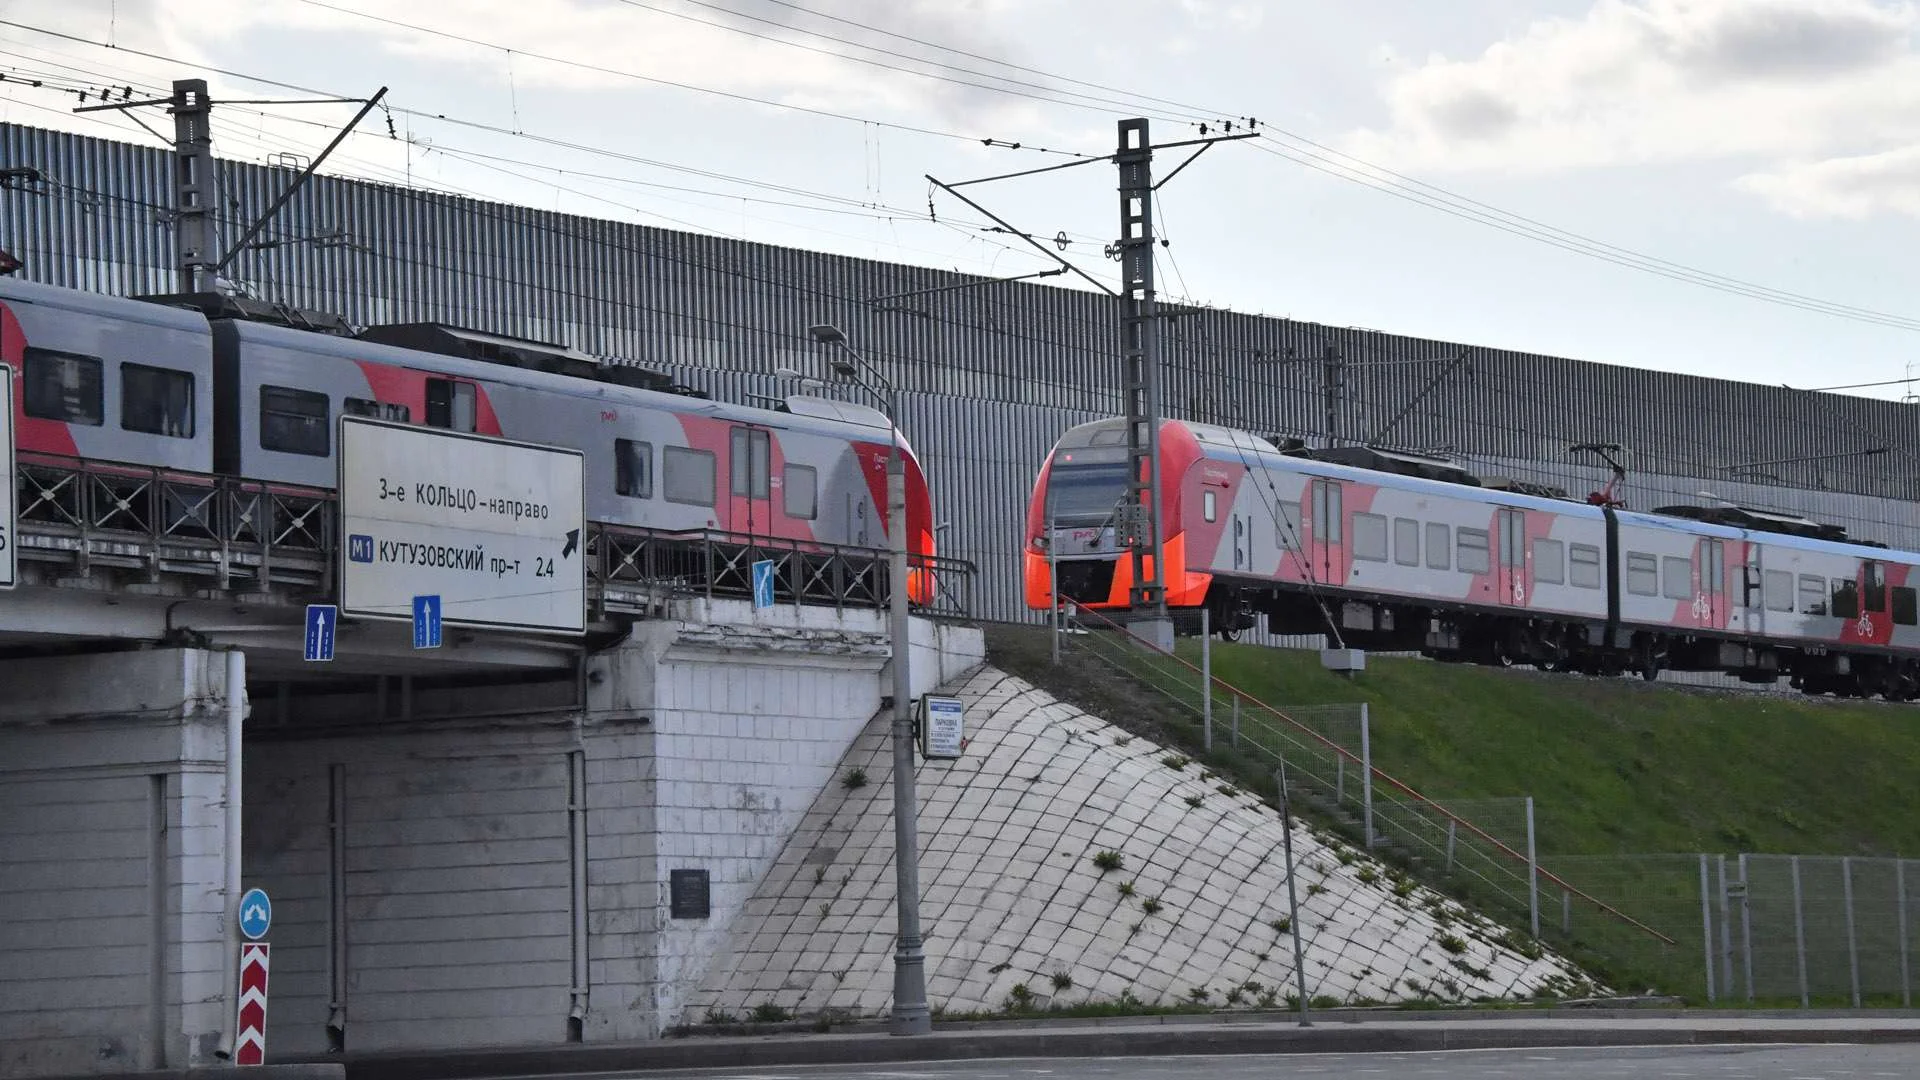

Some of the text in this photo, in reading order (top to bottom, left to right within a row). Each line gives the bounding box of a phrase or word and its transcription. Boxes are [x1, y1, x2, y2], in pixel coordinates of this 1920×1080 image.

[379, 478, 405, 502] 3-е
[352, 539, 554, 580] М1 КУТУЗОВСКИЙ пр-т 2.4
